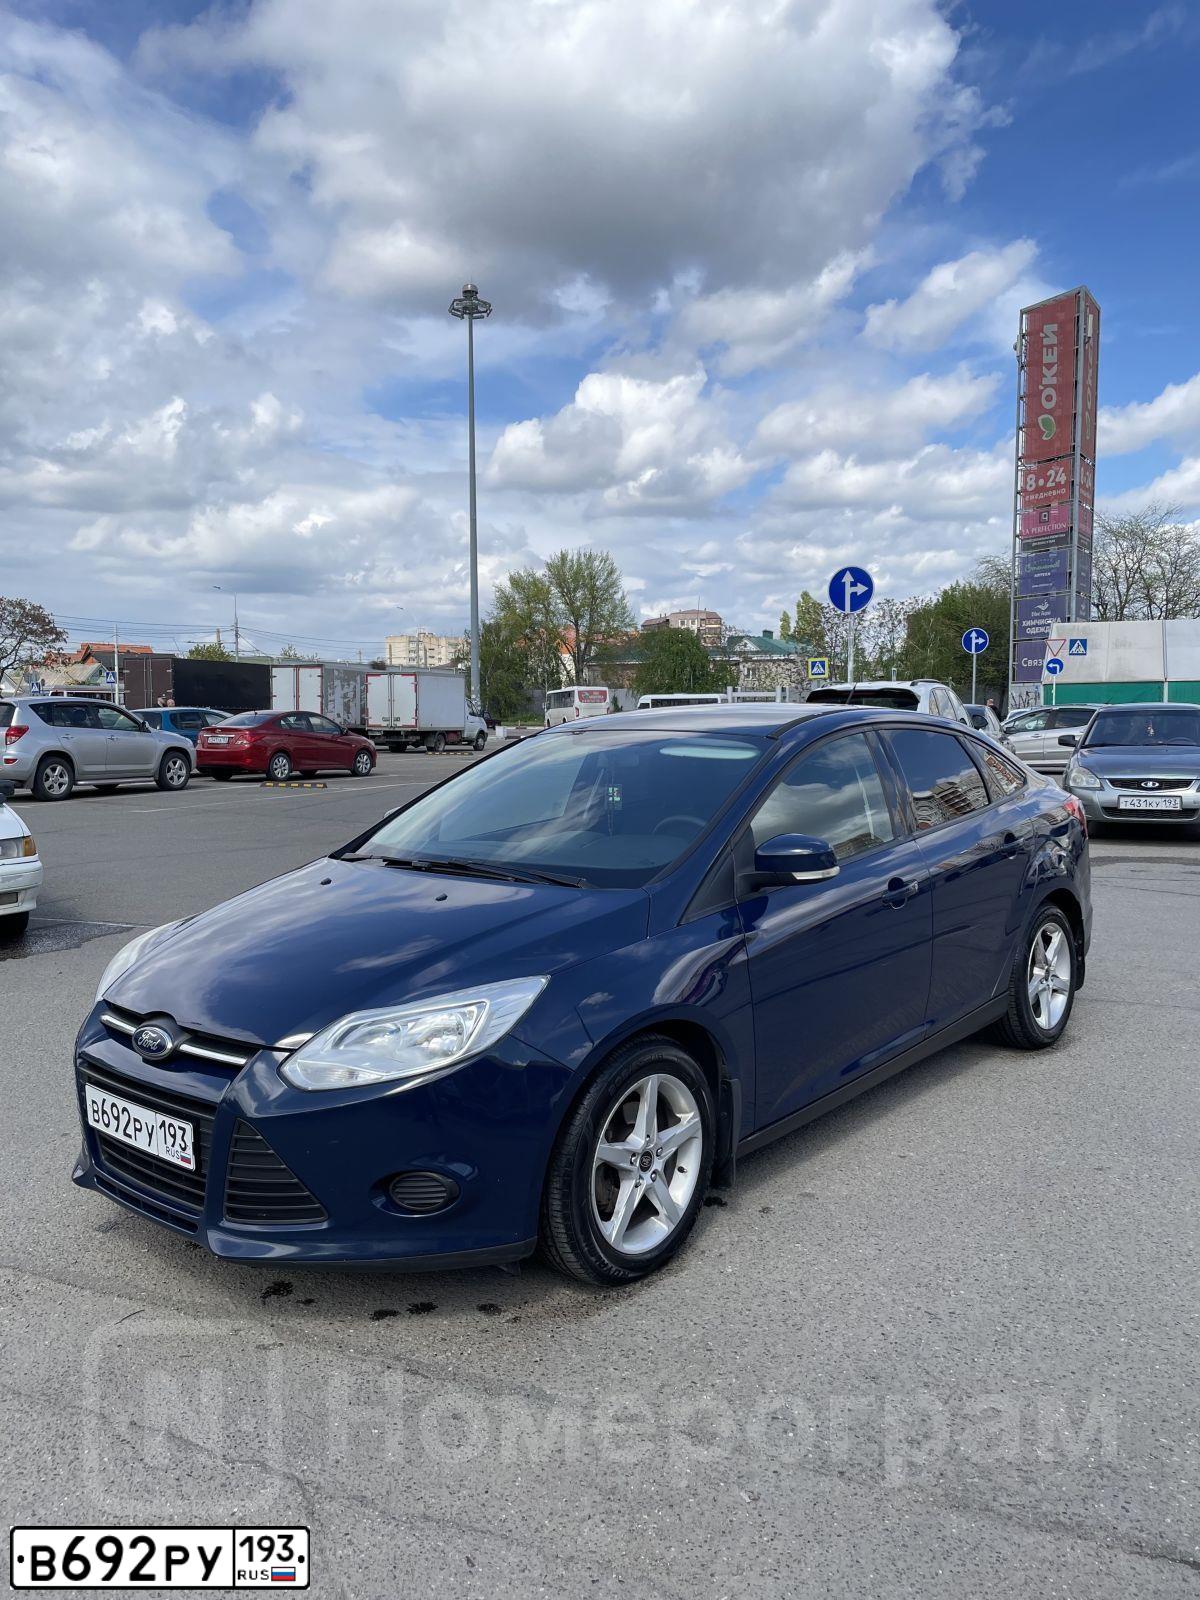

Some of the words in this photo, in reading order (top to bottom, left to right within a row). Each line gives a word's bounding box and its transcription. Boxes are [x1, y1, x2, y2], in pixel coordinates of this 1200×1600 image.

[1025, 488, 1066, 501] ежедневно
[1031, 522, 1067, 534] PERFECTION
[1026, 626, 1051, 635] ОДЕЖД
[137, 1030, 160, 1051] Ford
[91, 1098, 155, 1147] В692РУ
[158, 1118, 187, 1151] 193
[165, 1145, 180, 1160] RUS
